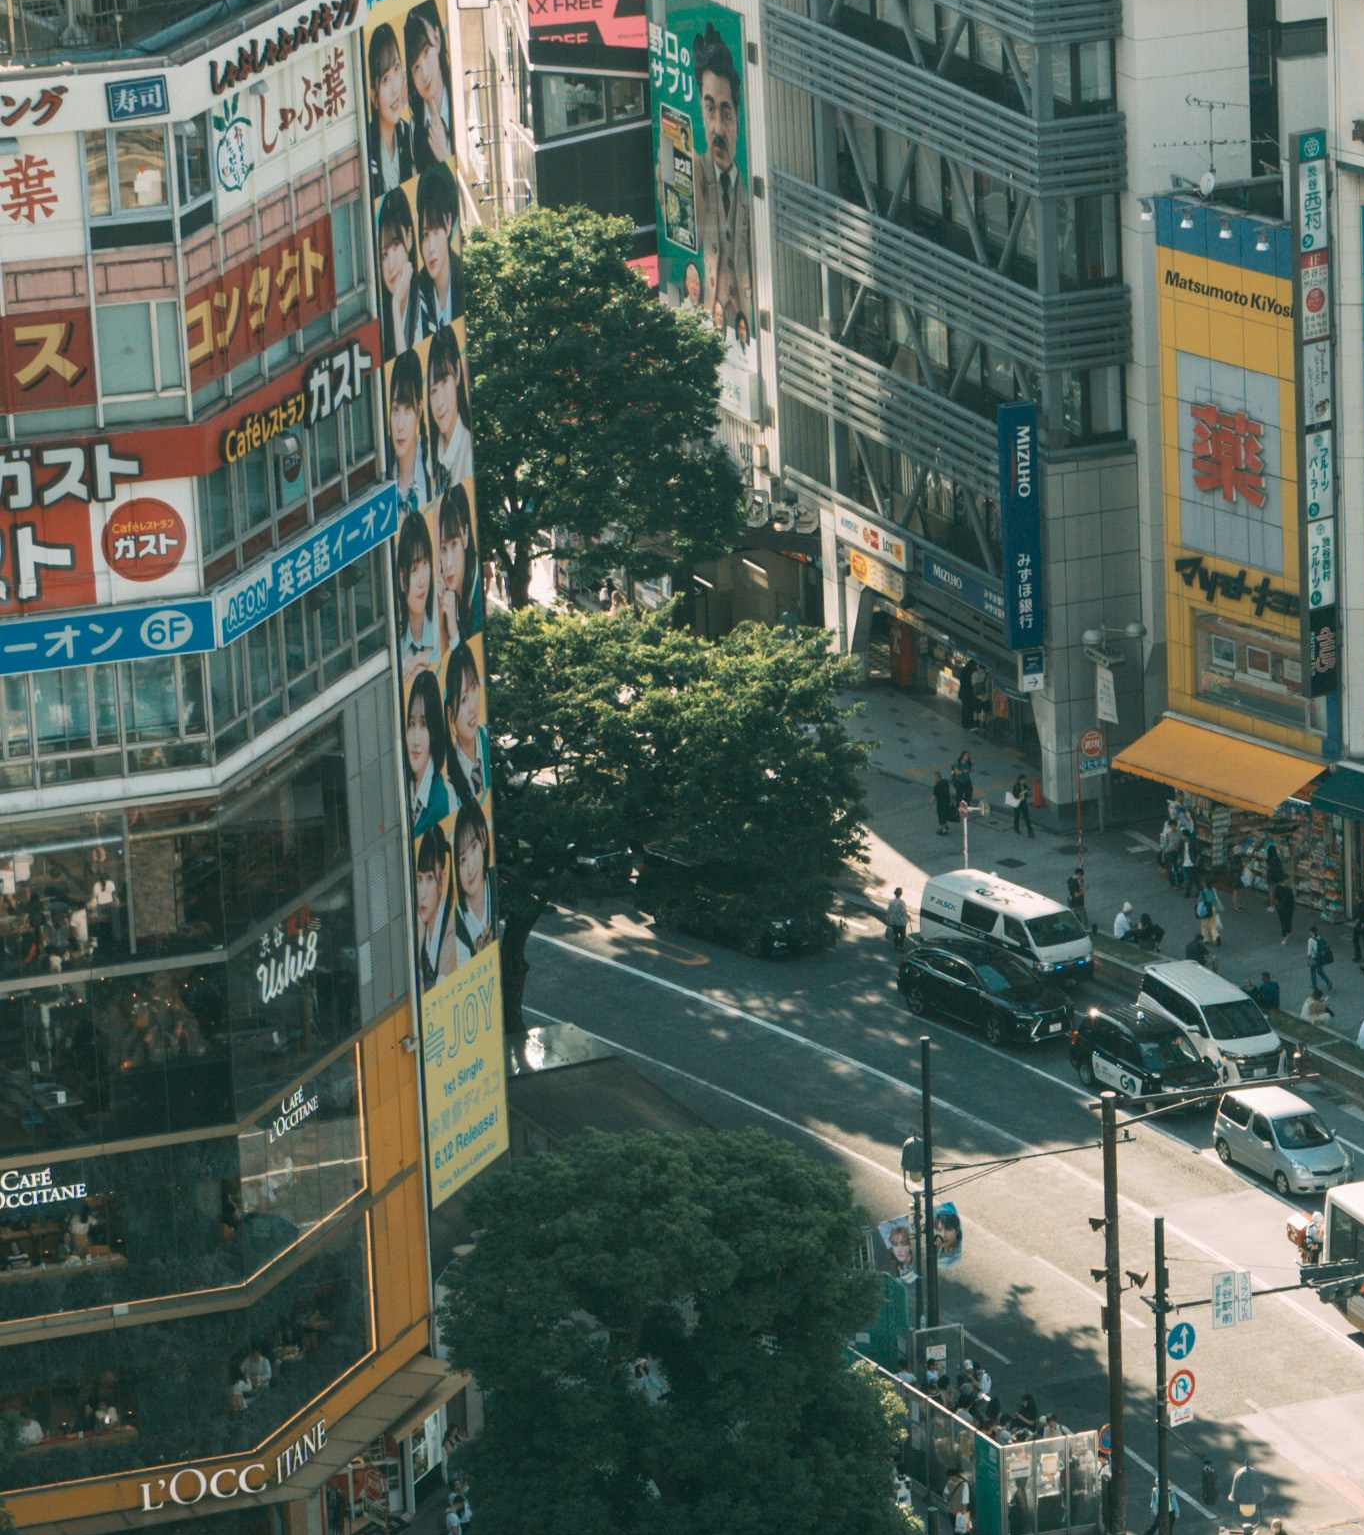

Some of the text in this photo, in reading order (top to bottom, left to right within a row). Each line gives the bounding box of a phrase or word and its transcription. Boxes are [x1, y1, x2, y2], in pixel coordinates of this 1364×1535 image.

[649, 22, 690, 67] 野口の
[113, 83, 163, 111] 寿司
[259, 47, 346, 154] しゃぶ葉
[651, 60, 693, 102] サプリ
[187, 237, 325, 360] コンタクト
[1165, 270, 1248, 306] Matsumoto
[13, 322, 80, 386] ス
[1191, 402, 1267, 509] 薬
[114, 534, 179, 561] ガスト
[227, 578, 268, 633] AEON
[147, 614, 187, 647] 6F
[1, 1167, 53, 1190] CAFÉ
